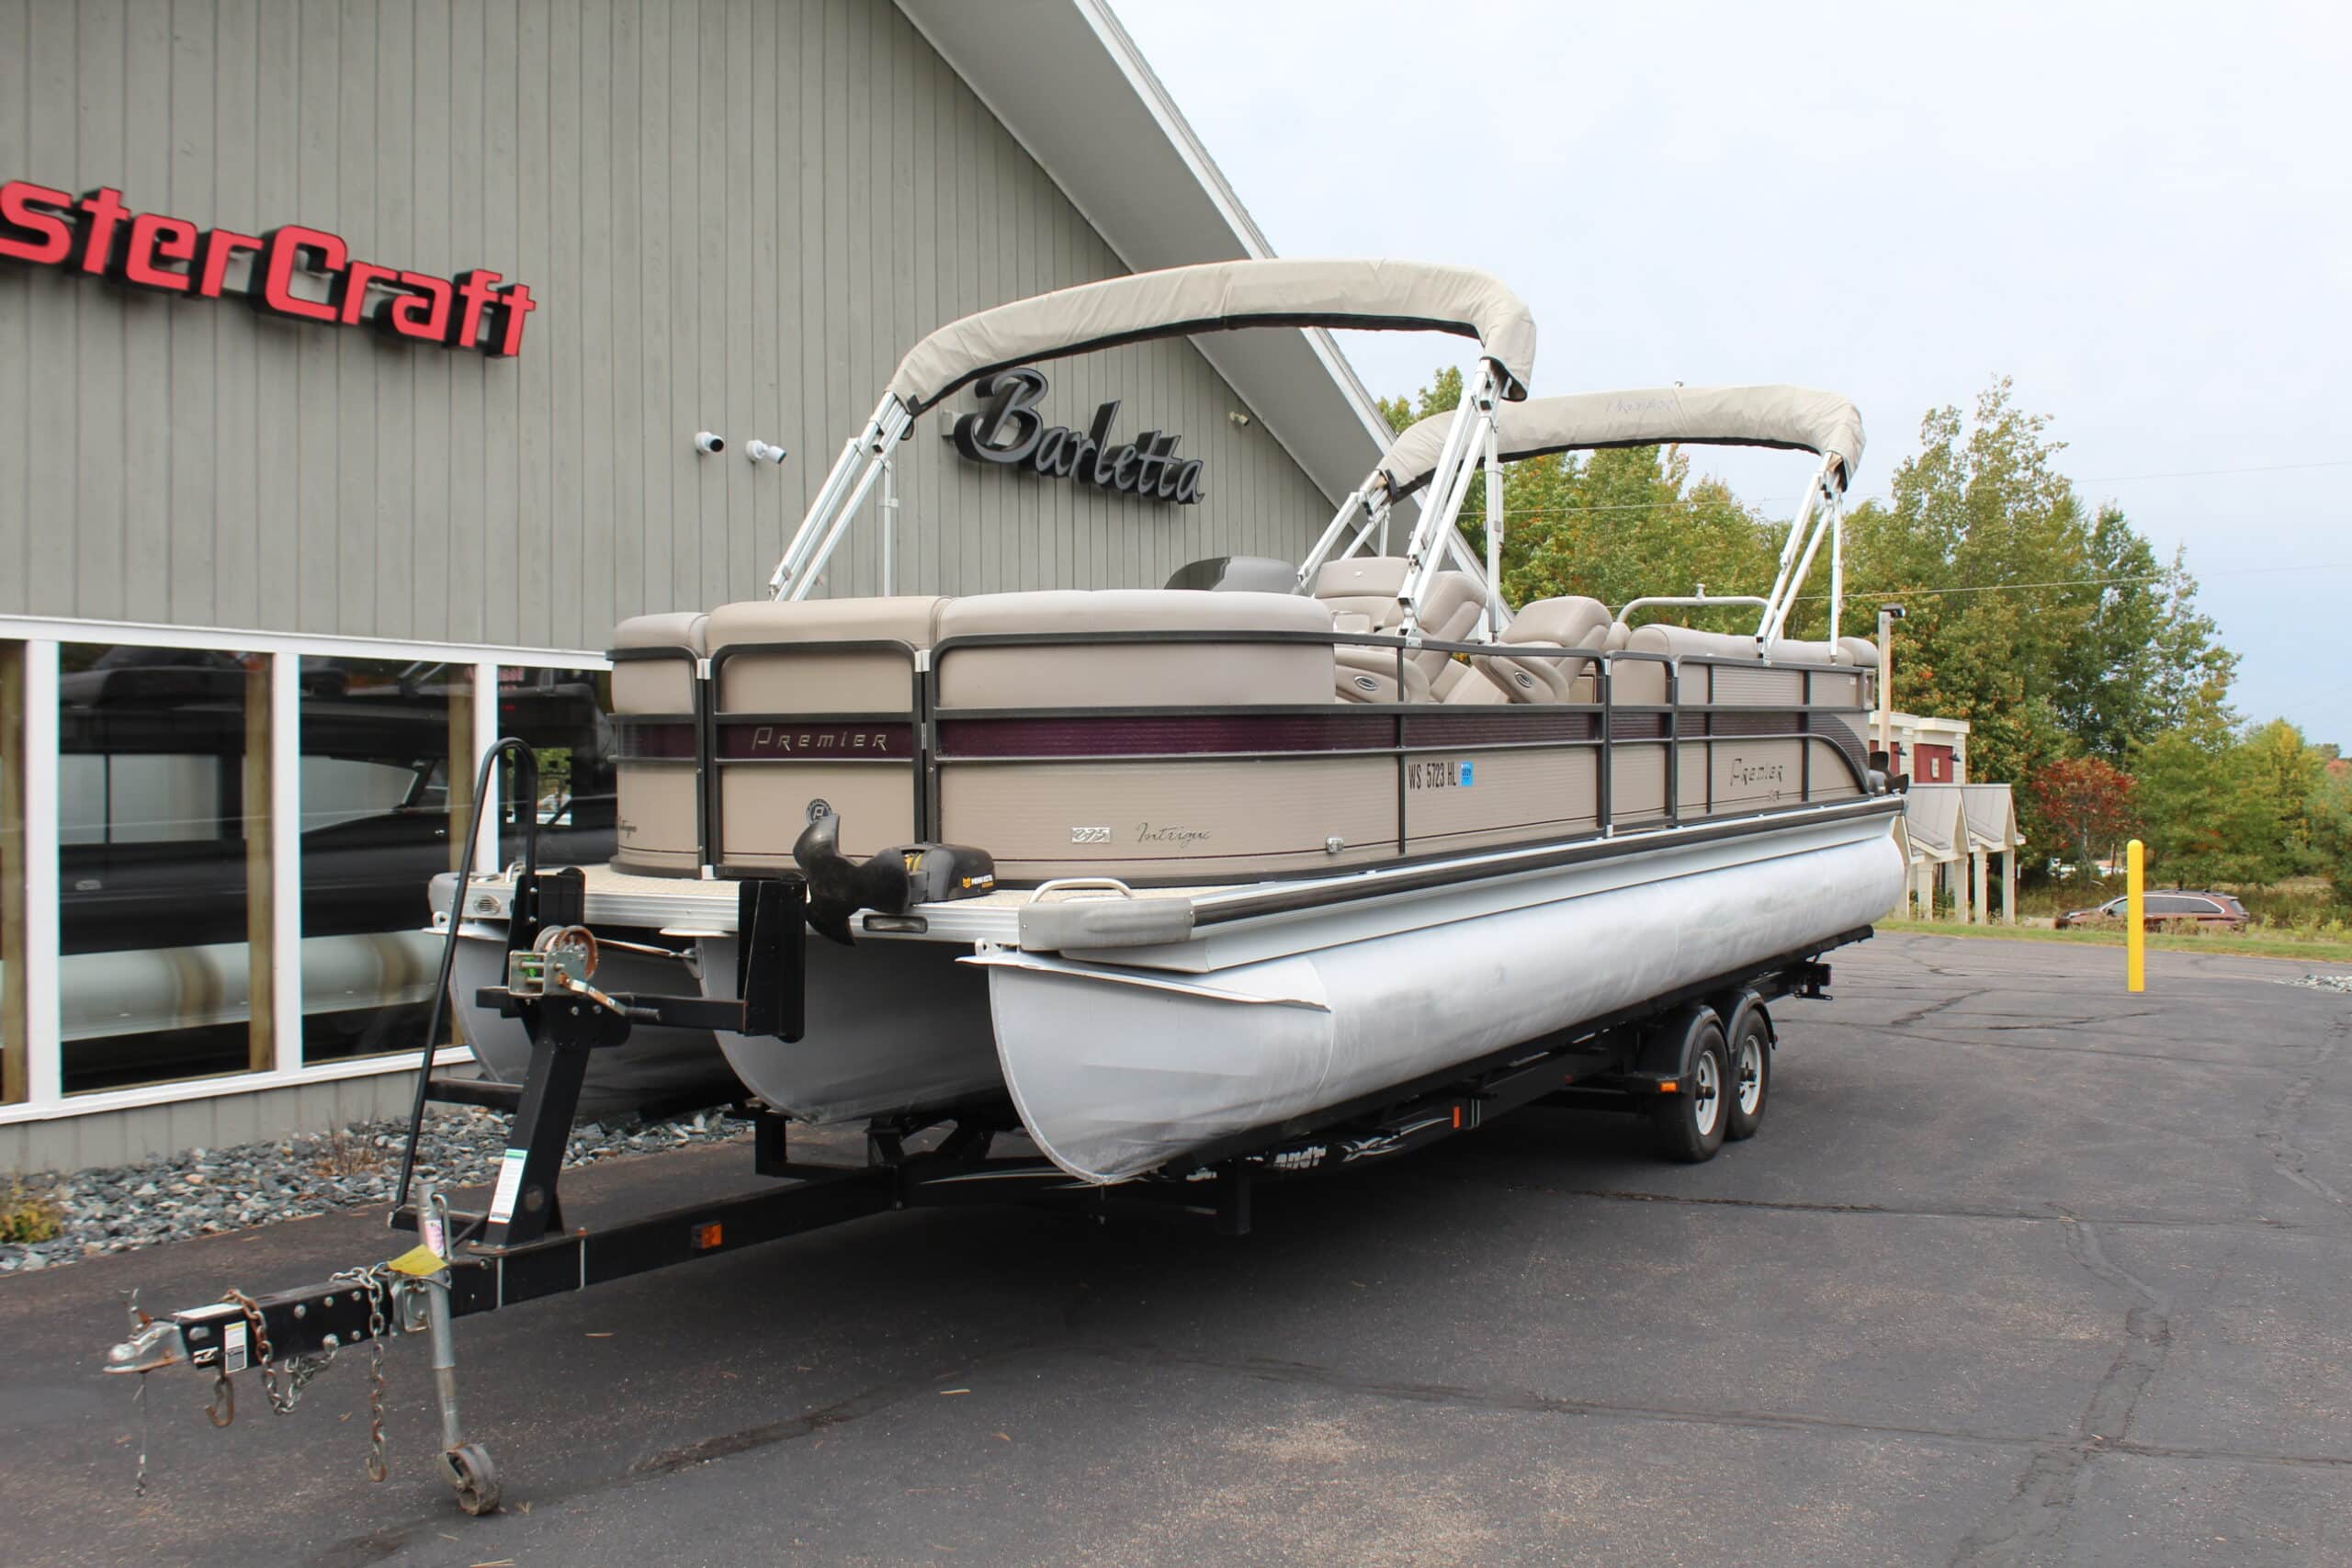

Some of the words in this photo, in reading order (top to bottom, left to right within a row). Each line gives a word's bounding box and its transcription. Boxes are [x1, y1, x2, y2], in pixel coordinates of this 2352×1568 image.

[0, 180, 537, 357] sterCraft
[956, 367, 1205, 504] Barletta
[1408, 763, 1422, 790] WS
[1426, 761, 1445, 788] 5723
[1447, 761, 1457, 787] HL
[1135, 822, 1213, 848] Intrigue
